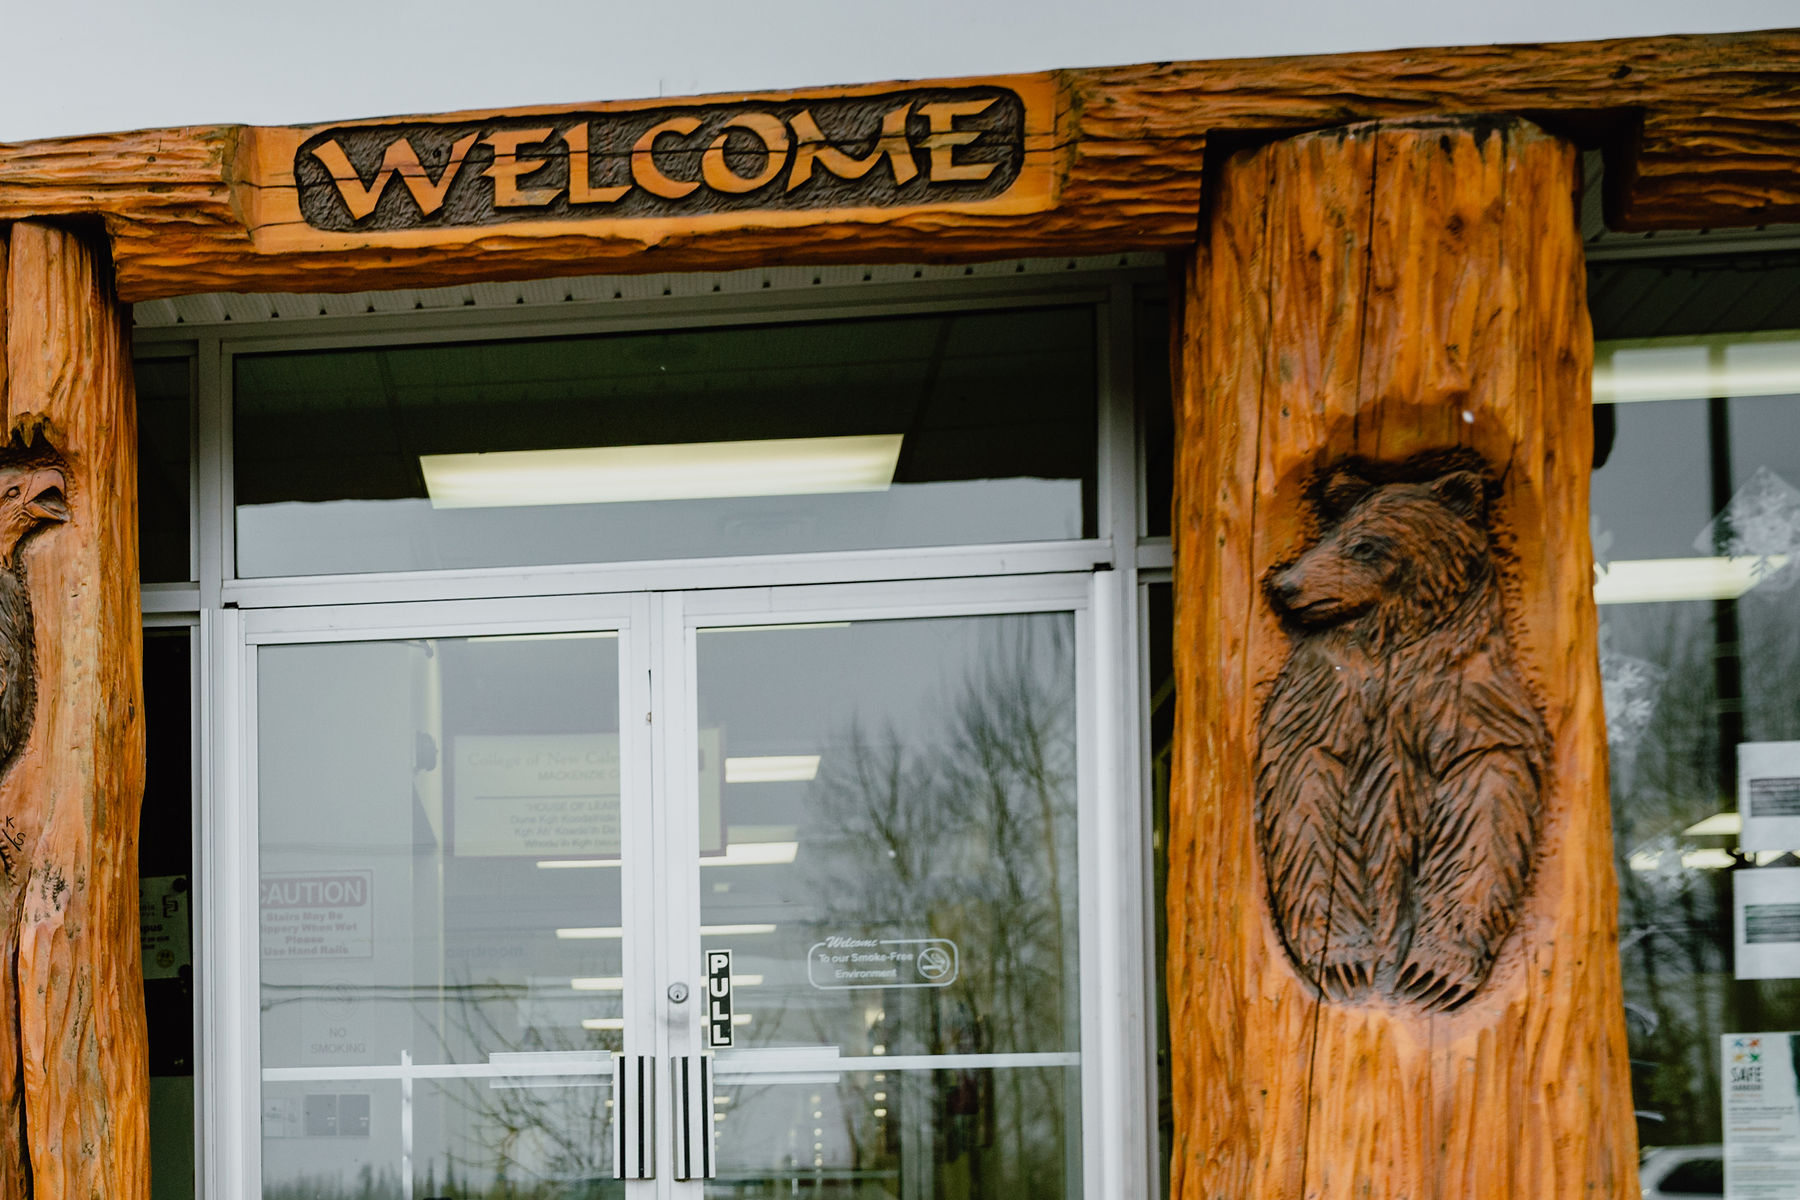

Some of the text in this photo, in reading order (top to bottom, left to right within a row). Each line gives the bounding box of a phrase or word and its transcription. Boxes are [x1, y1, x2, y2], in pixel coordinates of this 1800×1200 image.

[311, 96, 1000, 221] WELCOME
[266, 912, 300, 921] Stairs
[303, 912, 326, 922] May
[335, 923, 357, 931] Wet
[825, 936, 878, 948] Welcome
[818, 952, 913, 963] To our Smoke-Free
[835, 968, 897, 979] Environment
[710, 954, 731, 1044] PULL
[329, 1028, 346, 1038] NO
[311, 1043, 366, 1054] SMOKING
